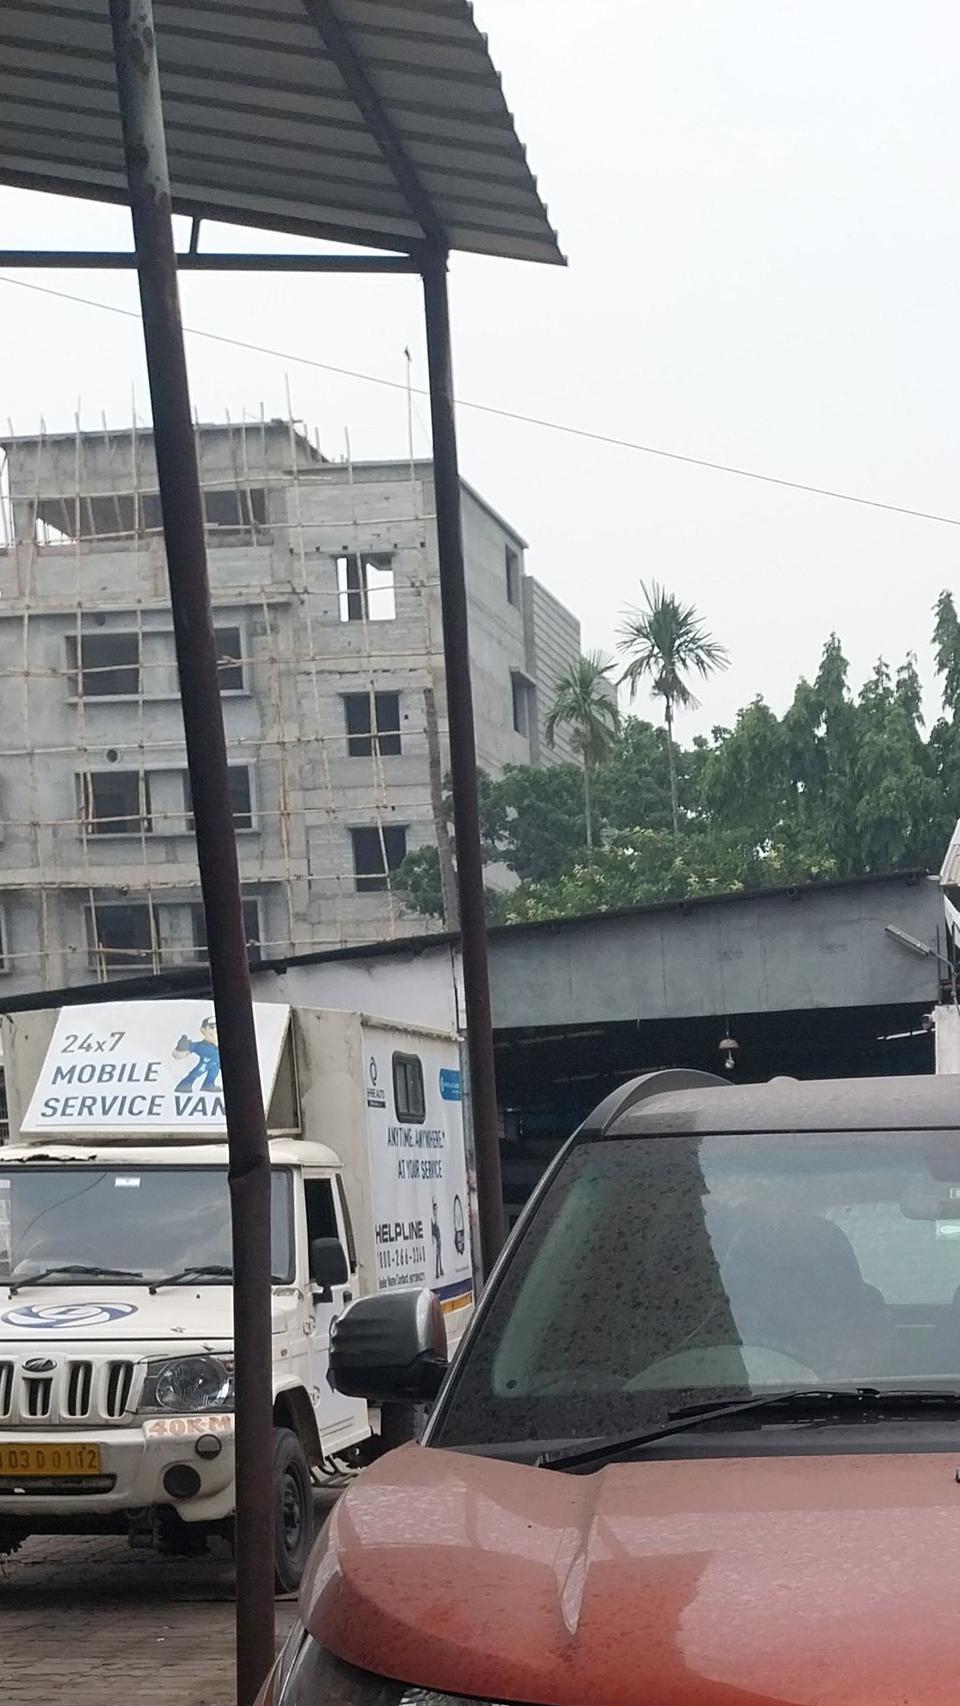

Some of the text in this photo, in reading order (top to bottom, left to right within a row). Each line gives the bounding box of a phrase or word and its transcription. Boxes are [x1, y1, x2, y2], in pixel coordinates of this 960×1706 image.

[61, 1032, 126, 1054] 24x7
[51, 1062, 162, 1085] MOBILE
[40, 1095, 165, 1118] SERVICE
[375, 1220, 424, 1244] HELPLINE
[9, 1449, 30, 1469] 03
[36, 1449, 46, 1469] D
